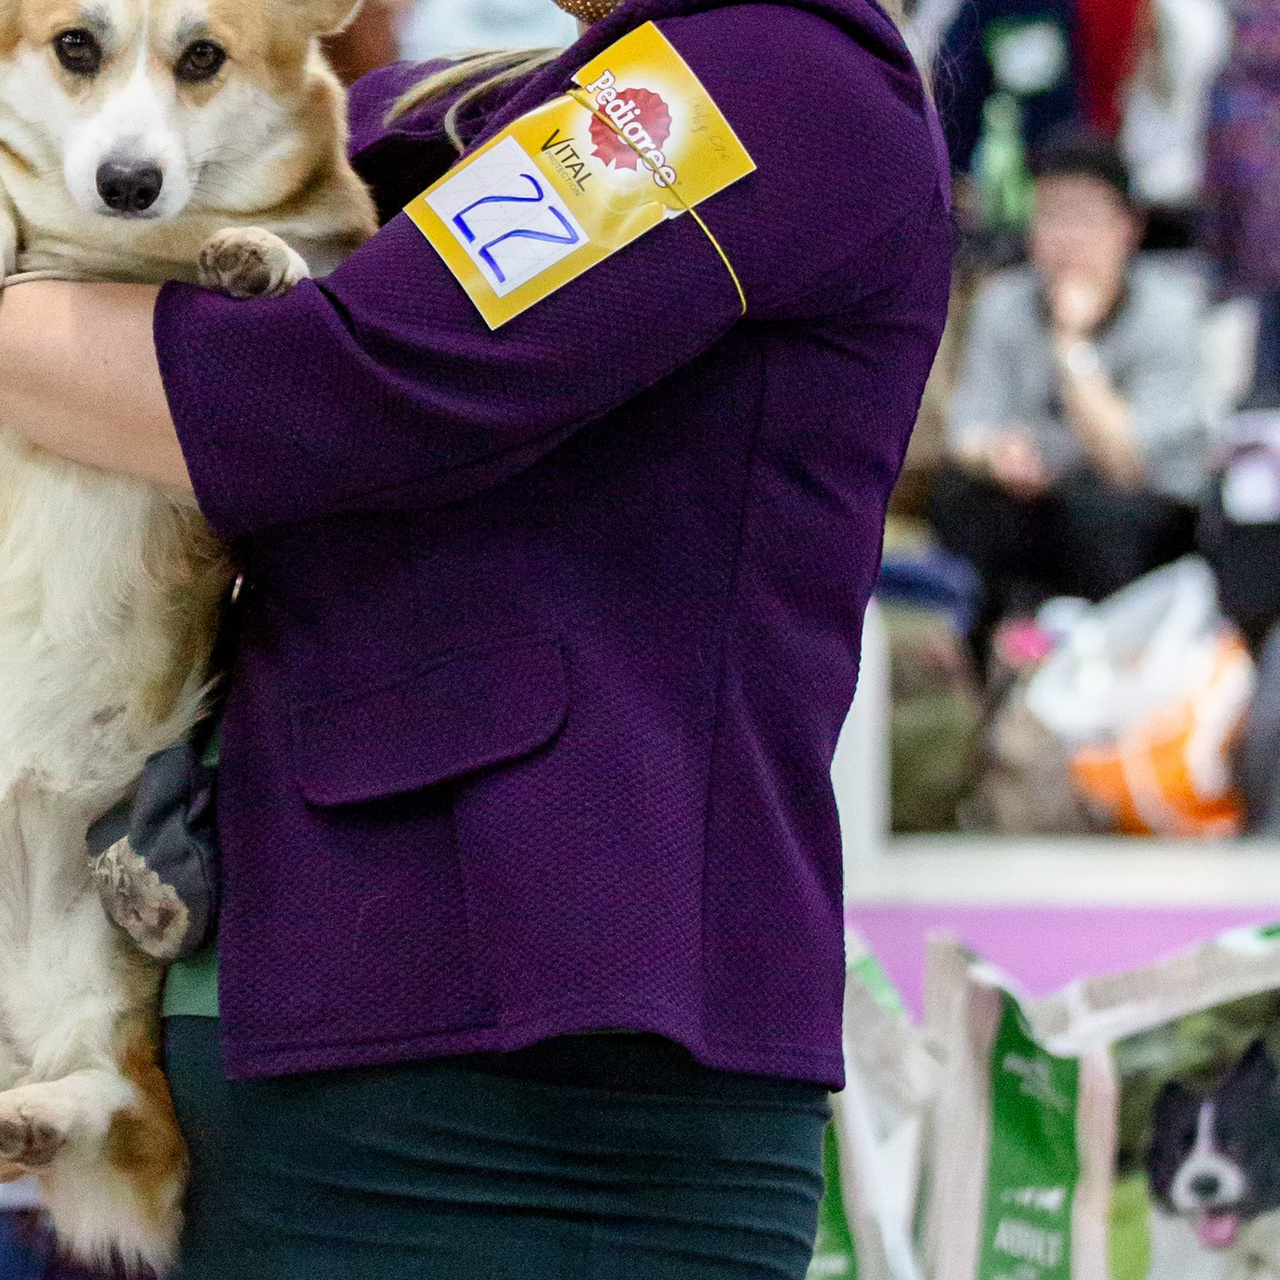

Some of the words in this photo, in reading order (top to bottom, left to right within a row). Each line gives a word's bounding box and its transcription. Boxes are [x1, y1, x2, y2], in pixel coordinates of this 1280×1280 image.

[541, 128, 593, 193] VITAL
[586, 70, 677, 188] Pedigree
[545, 150, 583, 197] PROTECTION
